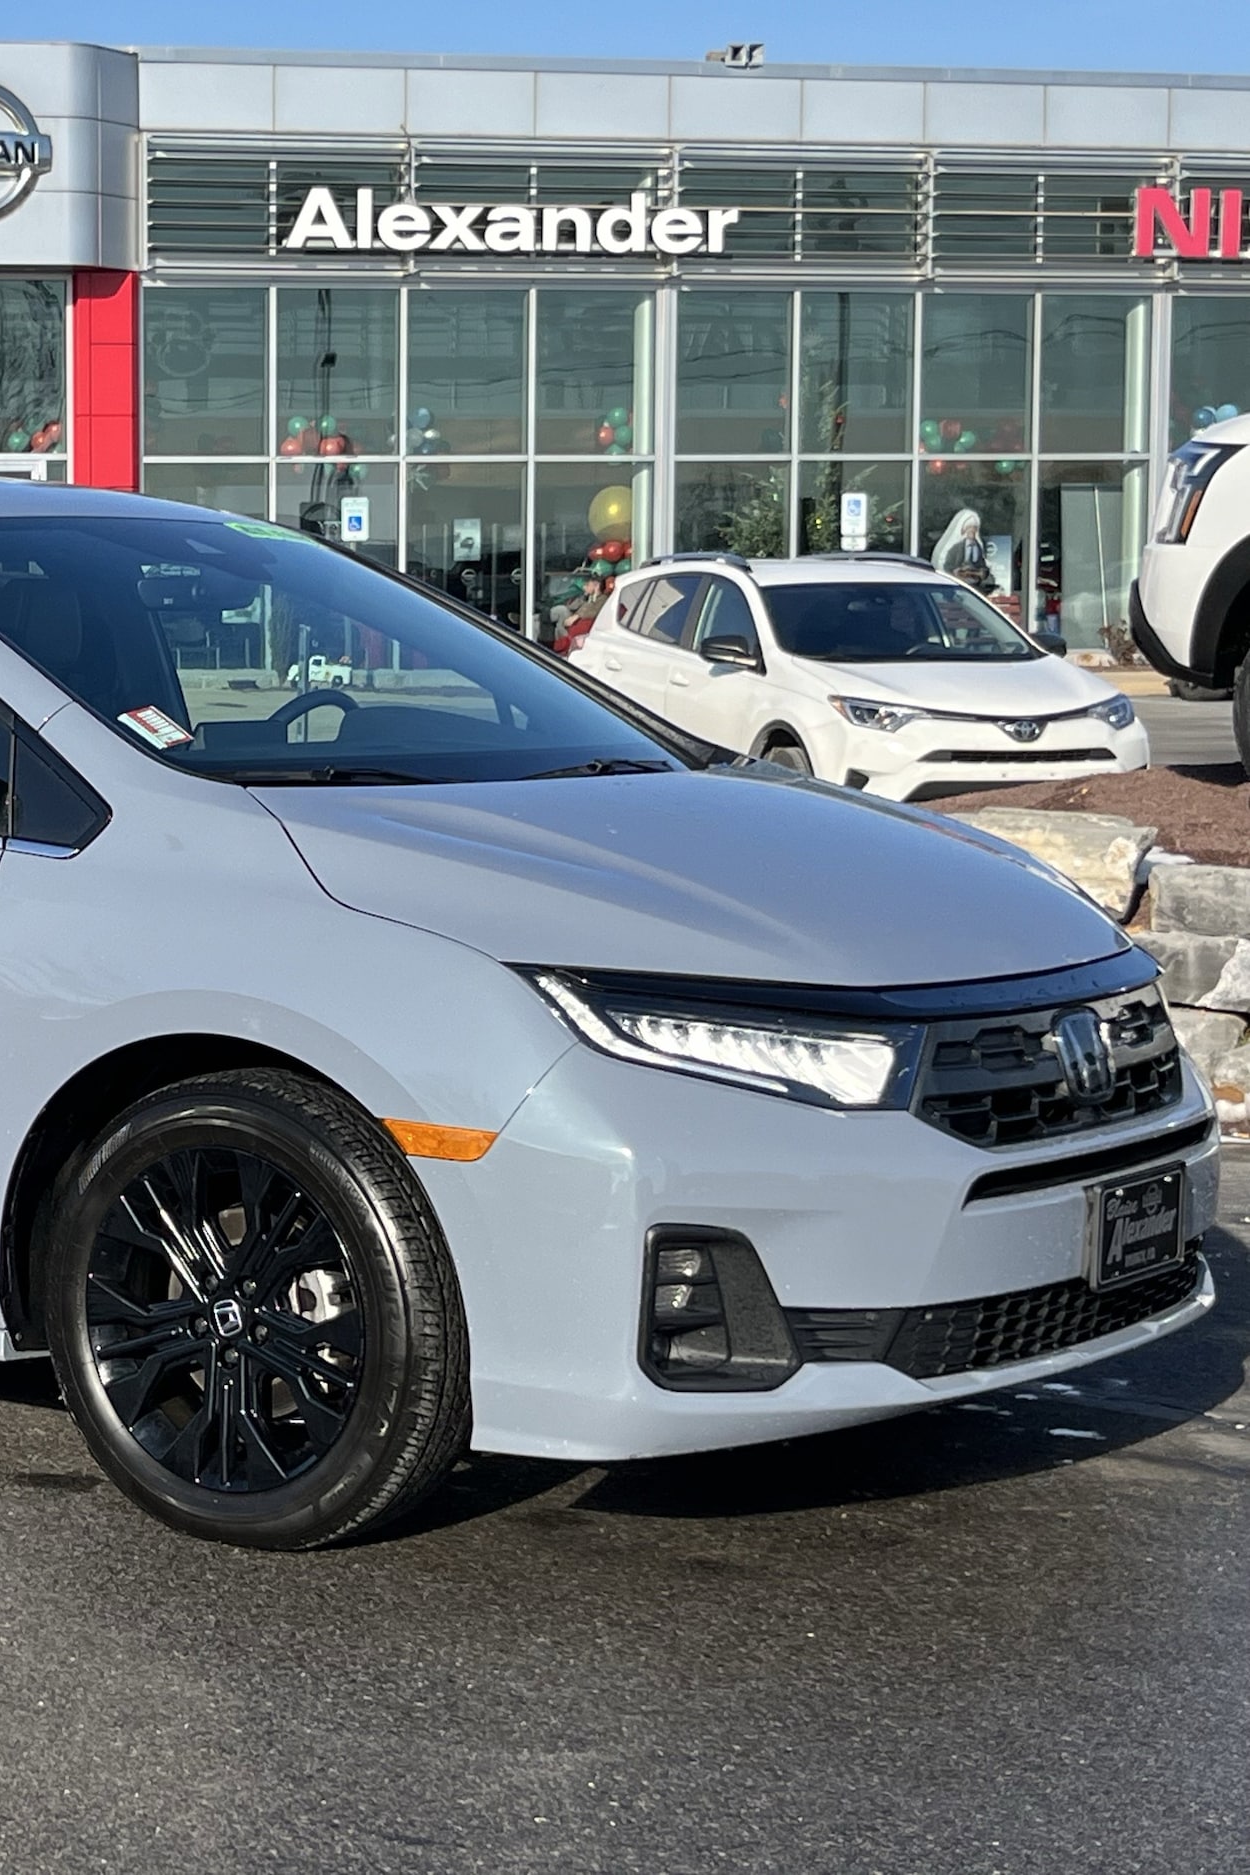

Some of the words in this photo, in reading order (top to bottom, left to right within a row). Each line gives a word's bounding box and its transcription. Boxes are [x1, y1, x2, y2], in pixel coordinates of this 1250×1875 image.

[285, 186, 739, 254] Alexander
[1133, 187, 1243, 259] NI
[1106, 1206, 1178, 1265] Alexander
